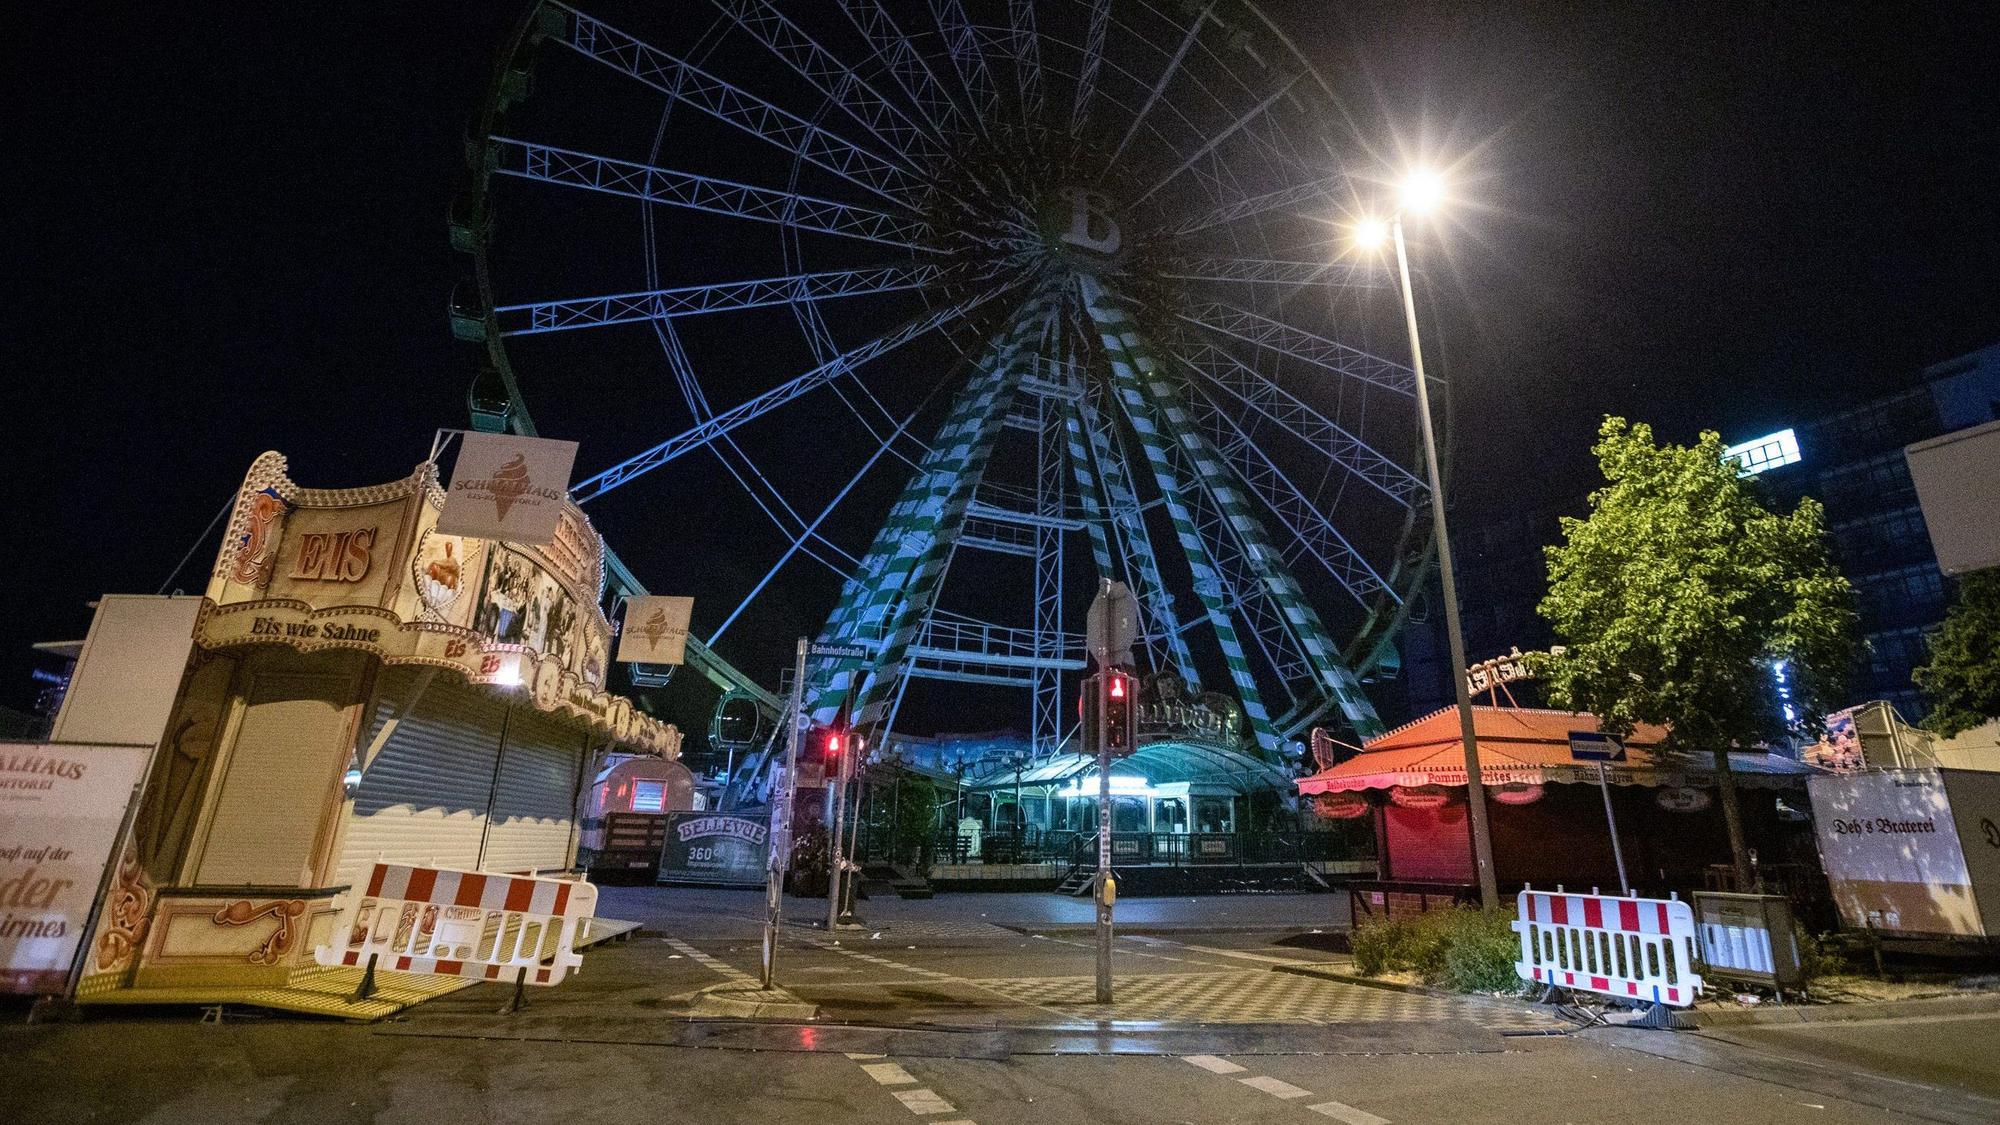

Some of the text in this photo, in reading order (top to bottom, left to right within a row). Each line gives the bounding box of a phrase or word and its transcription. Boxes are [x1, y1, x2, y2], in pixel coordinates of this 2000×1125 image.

[454, 479, 560, 500] SCHHAUS
[288, 527, 376, 583] EIS
[251, 617, 380, 643] Eis wie Sahne
[445, 639, 466, 657] Eis
[811, 644, 864, 657] Bahnhofstraße
[480, 654, 501, 674] Eis
[0, 755, 87, 780] LHAUS
[0, 779, 54, 790] ITOREI
[1428, 772, 1468, 784] Pomme
[681, 819, 765, 843] BELLEVUE
[1876, 817, 1936, 834] Braterei
[23, 845, 52, 864] auf
[49, 847, 73, 861] der
